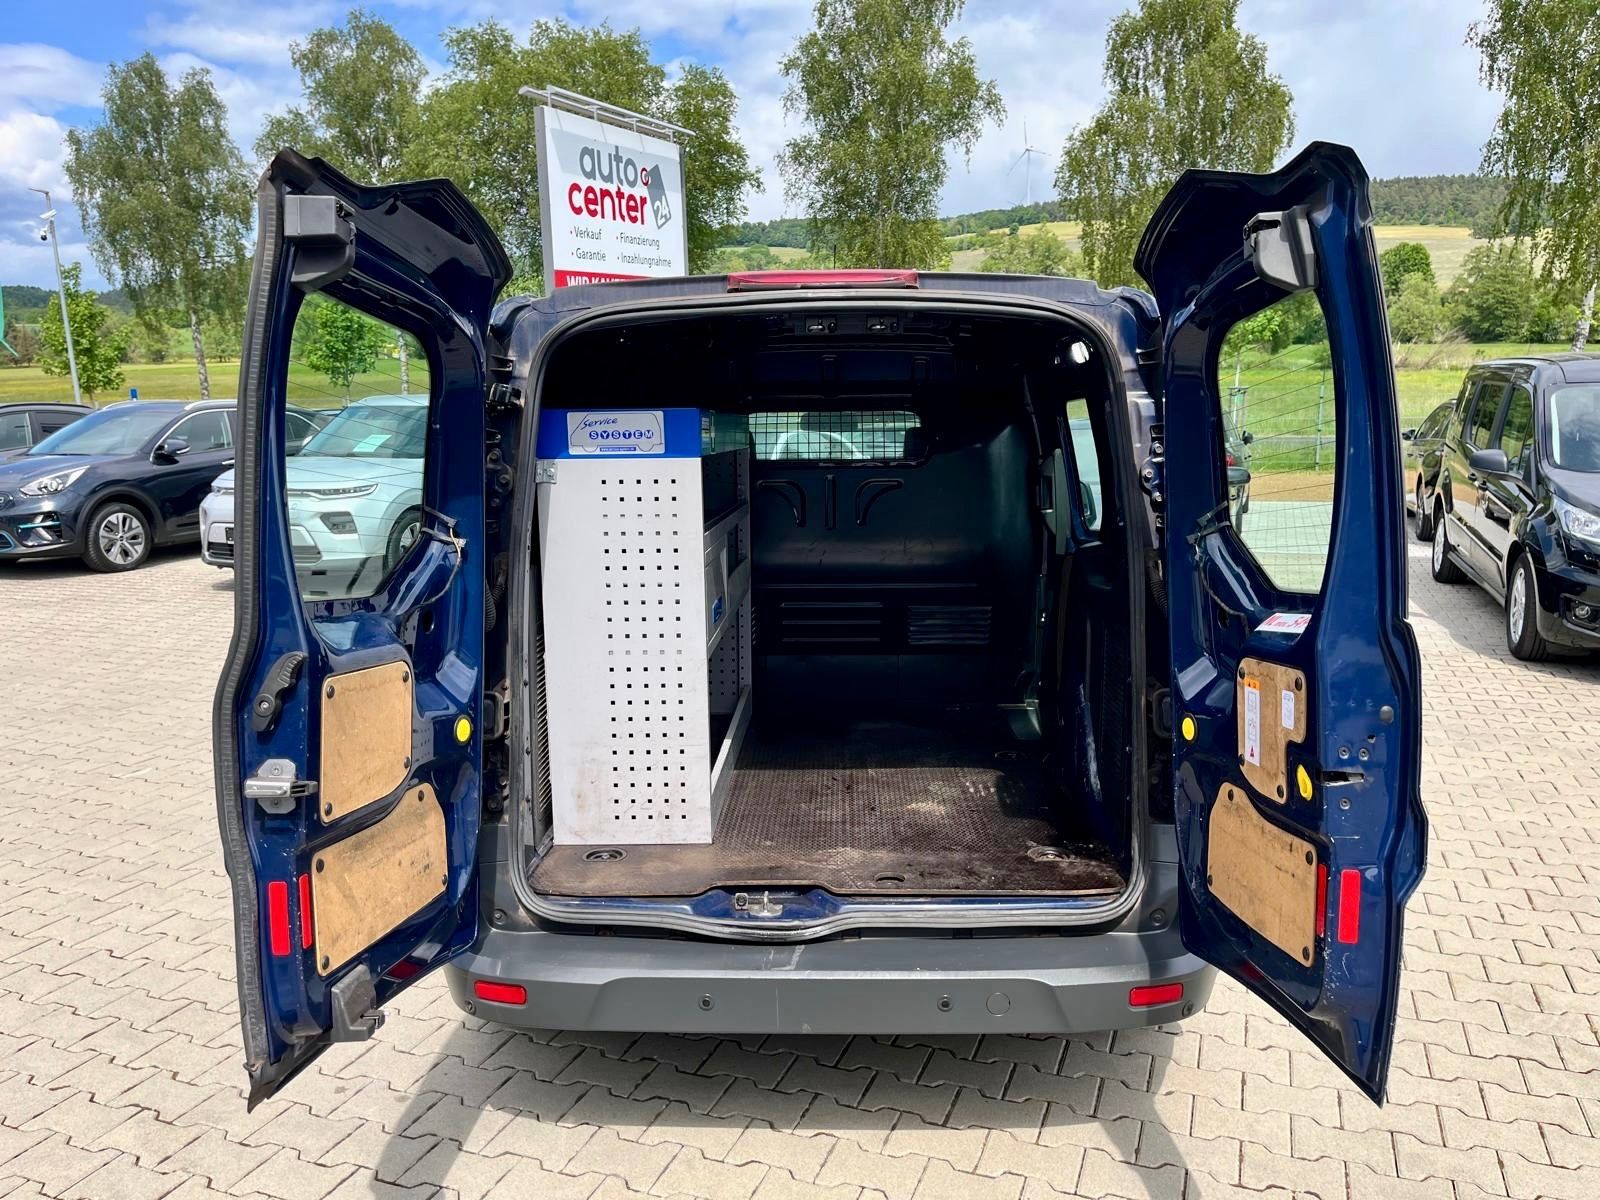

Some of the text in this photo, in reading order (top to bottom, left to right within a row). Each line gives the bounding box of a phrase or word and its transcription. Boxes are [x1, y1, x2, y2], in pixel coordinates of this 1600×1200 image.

[579, 145, 638, 188] auto
[568, 182, 647, 225] center
[654, 196, 670, 226] 24
[574, 226, 602, 241] Verkauf
[619, 232, 660, 250] Finanzierung
[575, 247, 606, 261] Garantie
[620, 252, 672, 268] Inzahlungnahme
[580, 417, 618, 431] Service
[589, 430, 653, 440] SYSTEM
